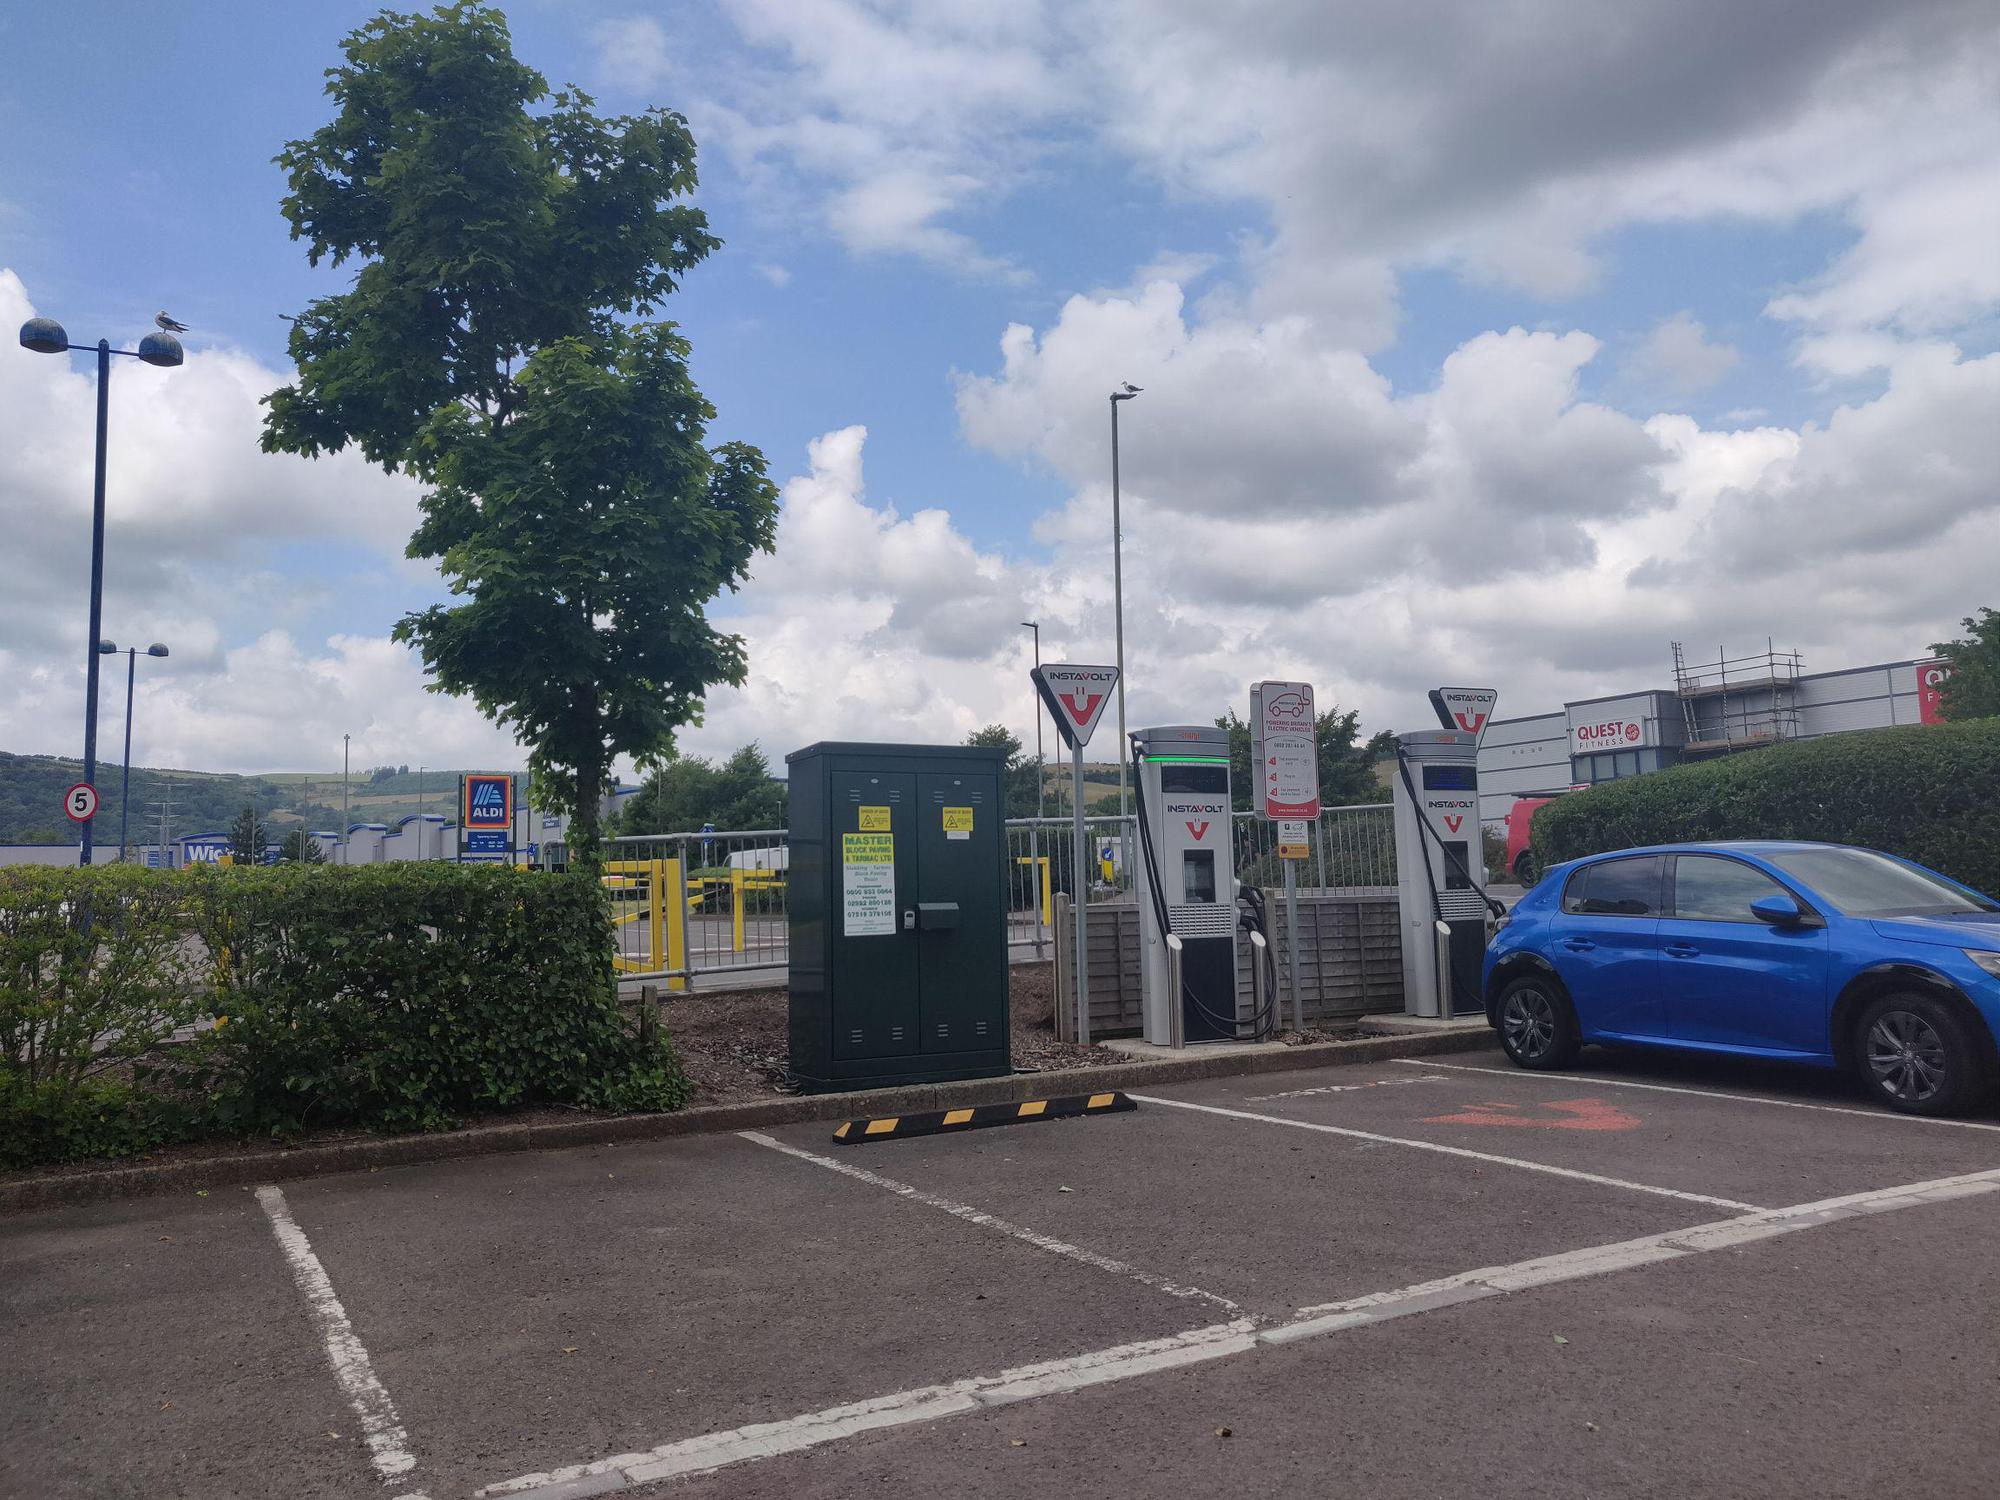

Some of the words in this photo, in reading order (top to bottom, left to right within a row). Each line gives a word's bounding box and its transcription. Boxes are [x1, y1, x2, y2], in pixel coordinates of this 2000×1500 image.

[1049, 672, 1112, 681] INSTAVOLT
[1447, 694, 1492, 703] INSTAVOLT
[1577, 722, 1623, 741] QUEST
[1579, 738, 1624, 750] FITNESS
[74, 792, 88, 812] 5
[1429, 800, 1474, 809] INSTAVOLT
[473, 807, 503, 817] ALDI
[1167, 804, 1224, 813] INSTAVOLT
[845, 836, 892, 845] MASTER
[852, 854, 879, 862] TARMAC
